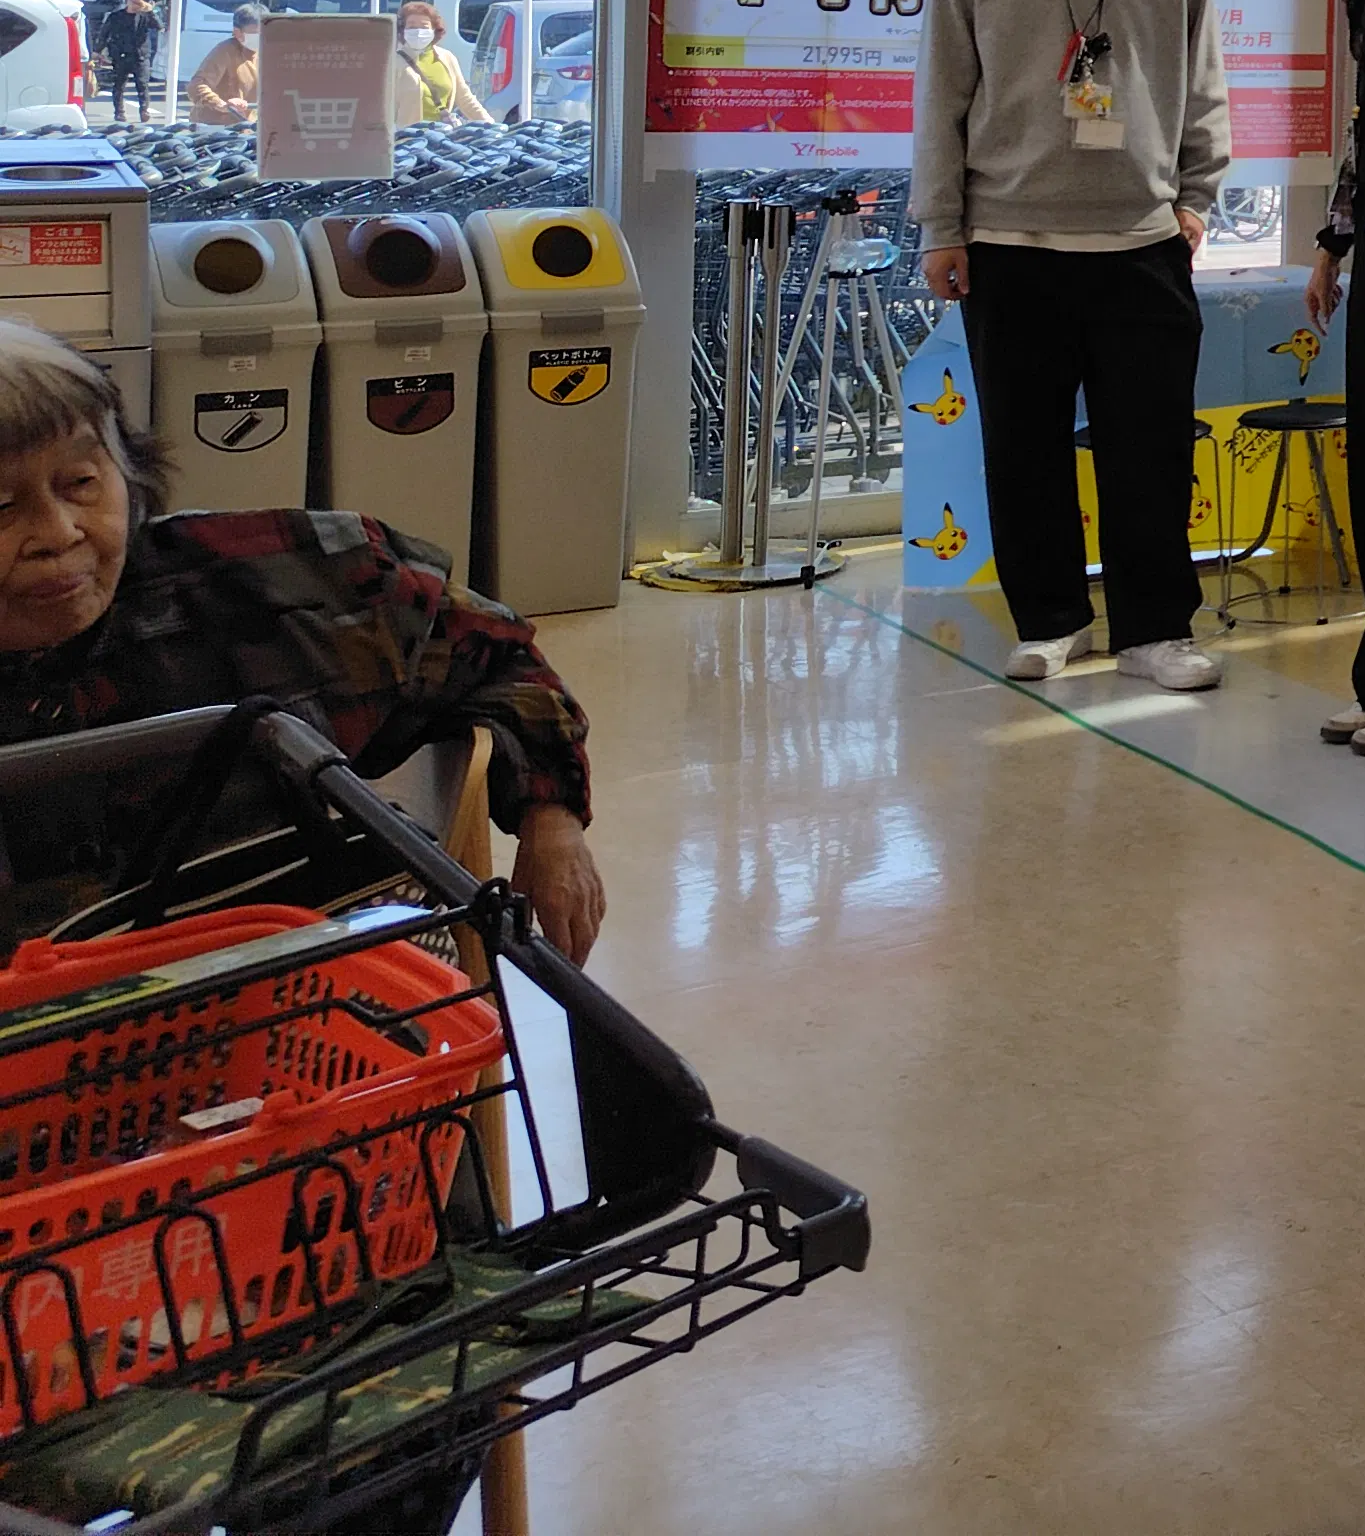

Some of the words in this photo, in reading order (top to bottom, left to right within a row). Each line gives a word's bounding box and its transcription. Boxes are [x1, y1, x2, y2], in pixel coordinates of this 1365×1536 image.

[802, 45, 882, 66] 21,995円
[540, 350, 601, 360] ペットボトル
[394, 378, 427, 389] ビン
[223, 393, 261, 404] カン
